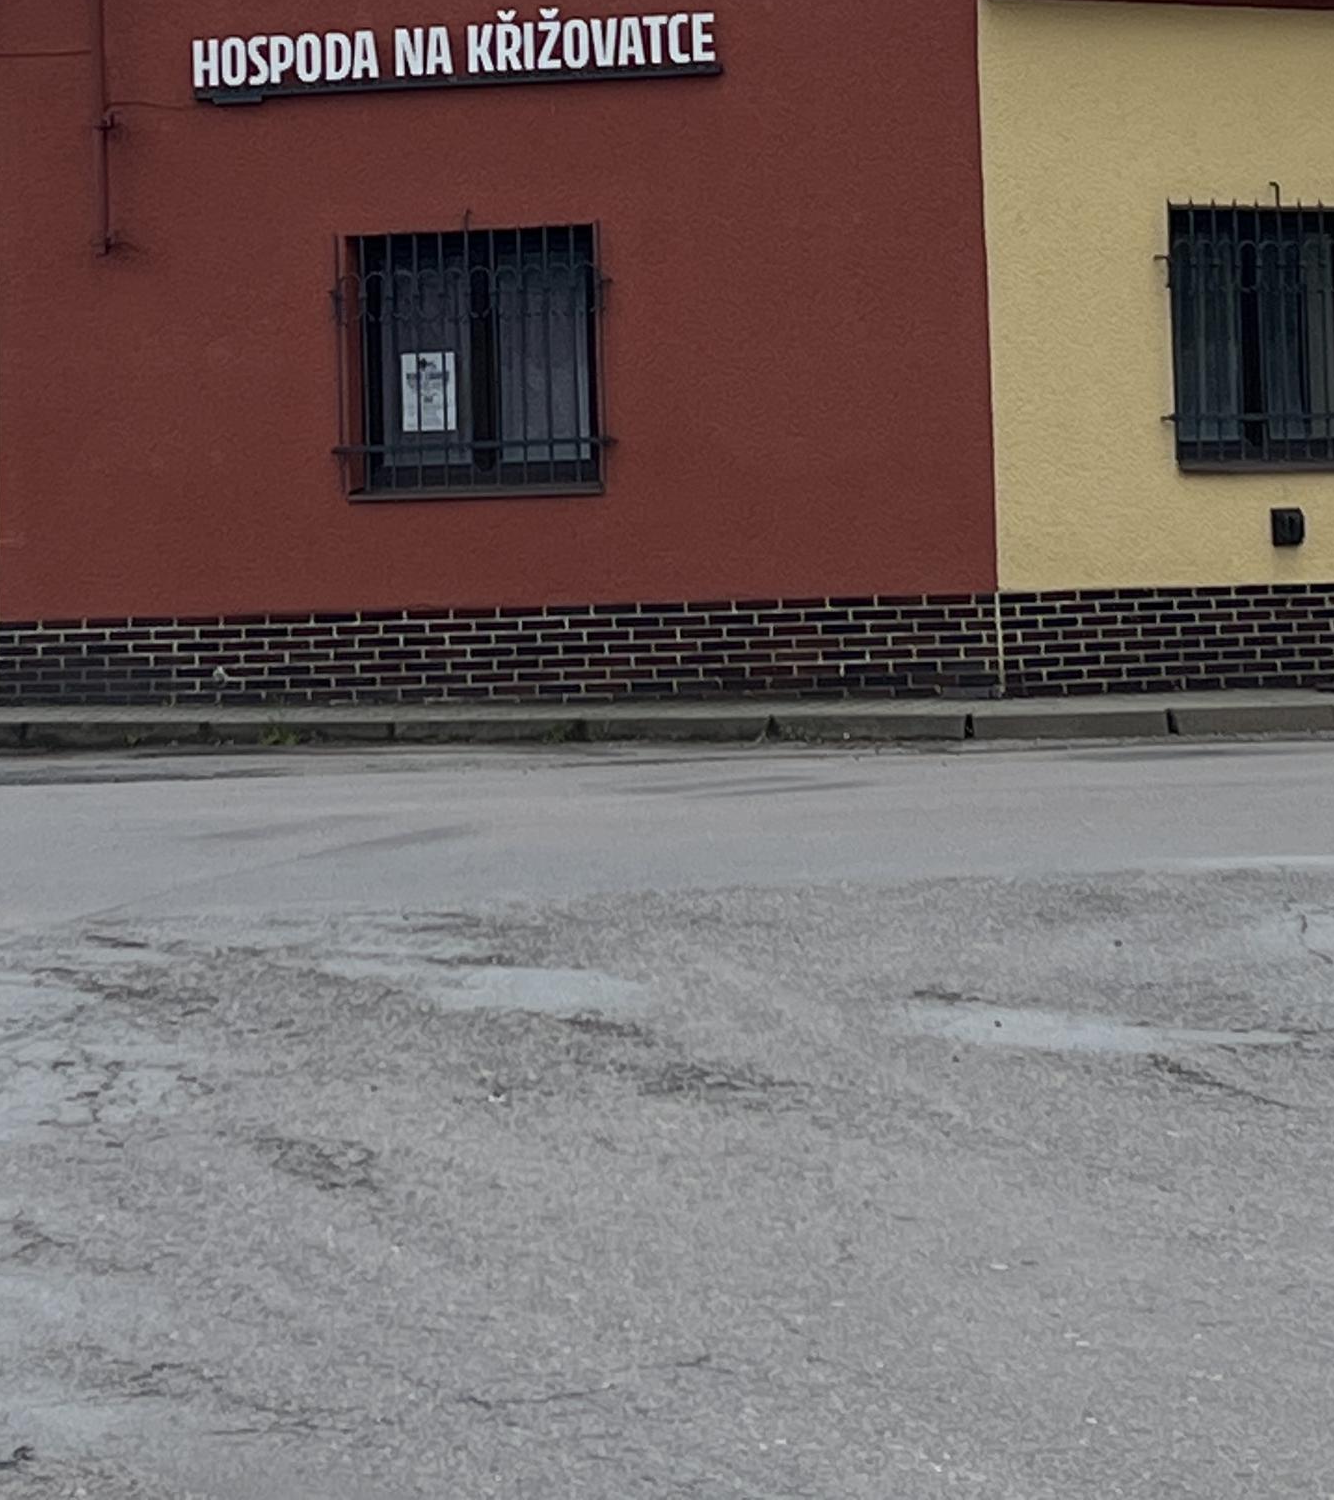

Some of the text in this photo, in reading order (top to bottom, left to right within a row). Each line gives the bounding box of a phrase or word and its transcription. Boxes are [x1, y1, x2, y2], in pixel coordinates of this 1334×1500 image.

[192, 8, 716, 88] HOSPODA NA KŘIŽOVATCE
